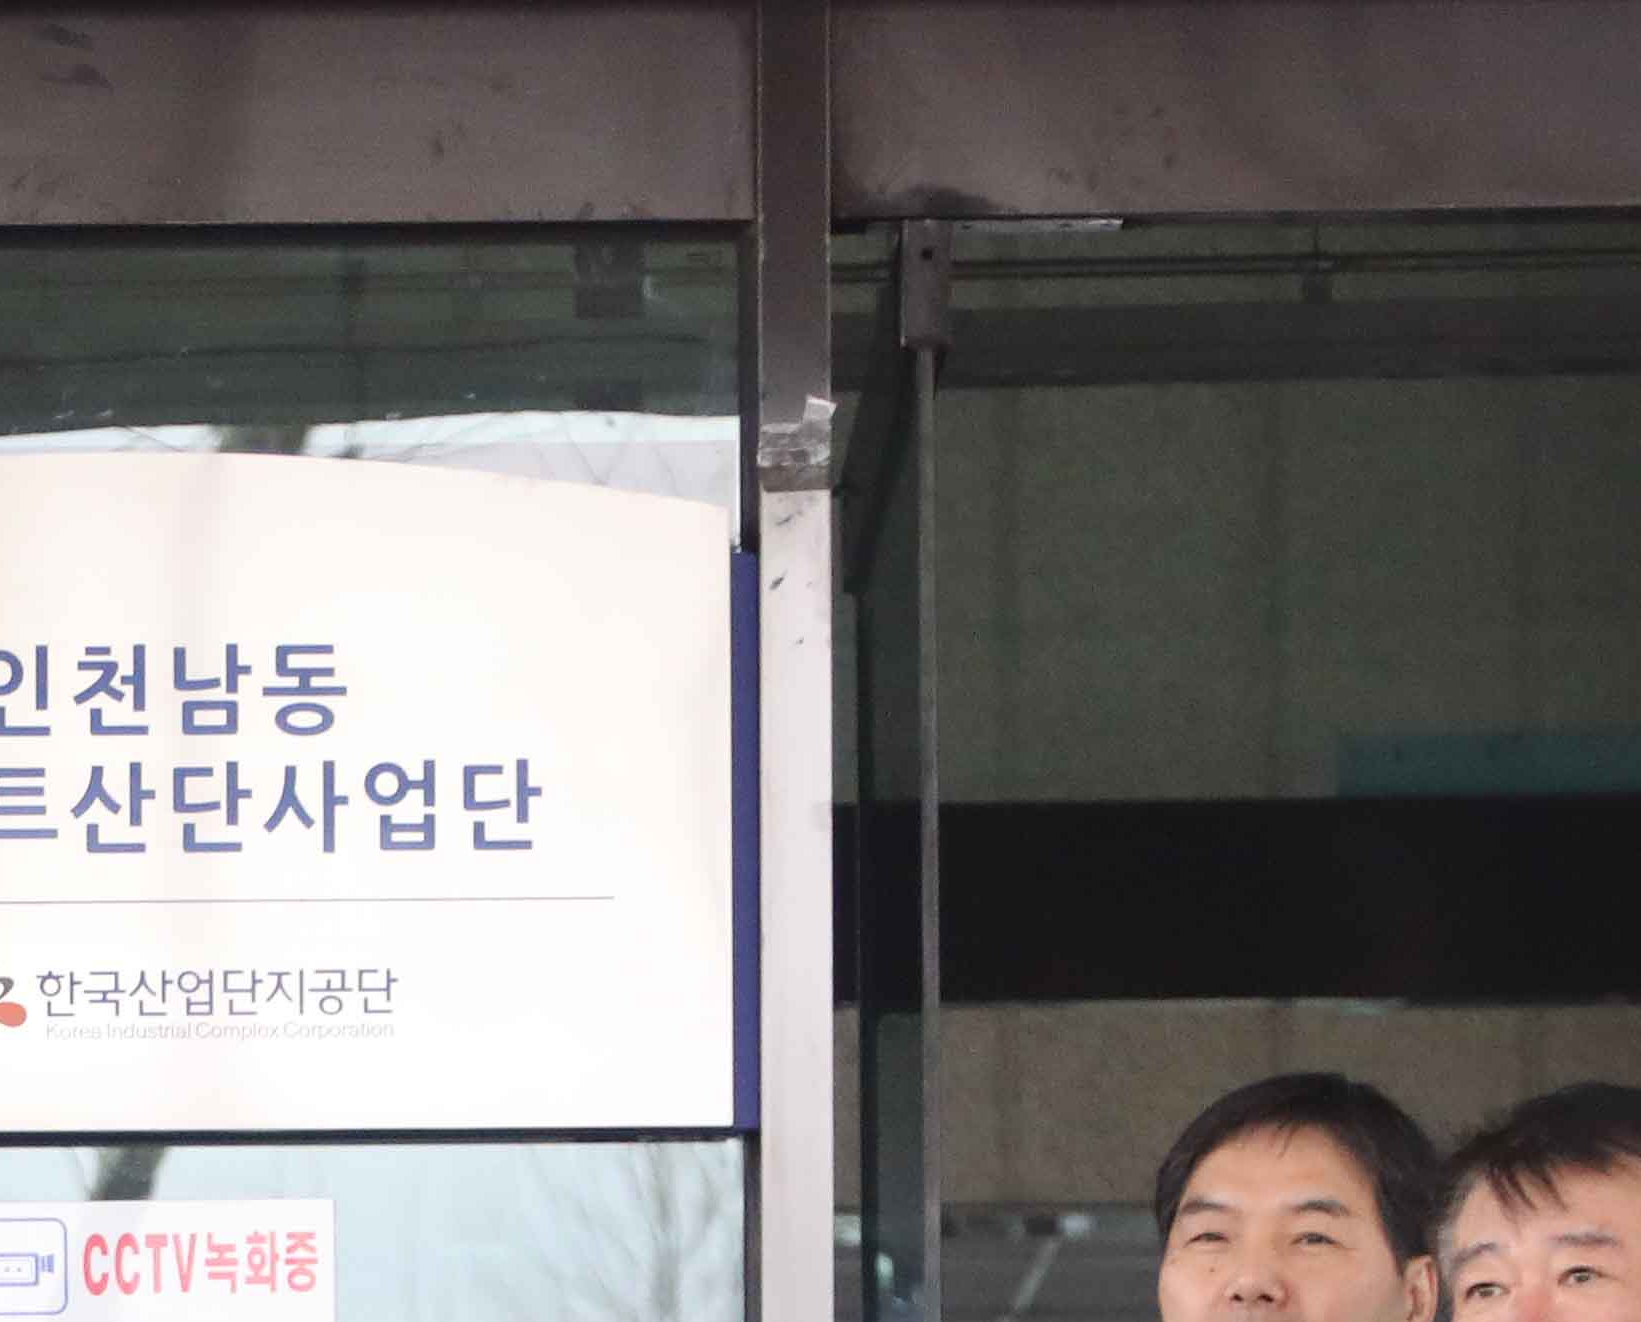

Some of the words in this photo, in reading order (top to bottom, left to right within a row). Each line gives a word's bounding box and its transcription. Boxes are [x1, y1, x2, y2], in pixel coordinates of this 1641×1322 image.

[35, 967, 400, 1018] 한국산업단지공단
[45, 1023, 102, 1040] Korea
[106, 1022, 192, 1040] Industrial
[195, 1020, 280, 1042] Complex
[283, 1020, 395, 1040] Corporation
